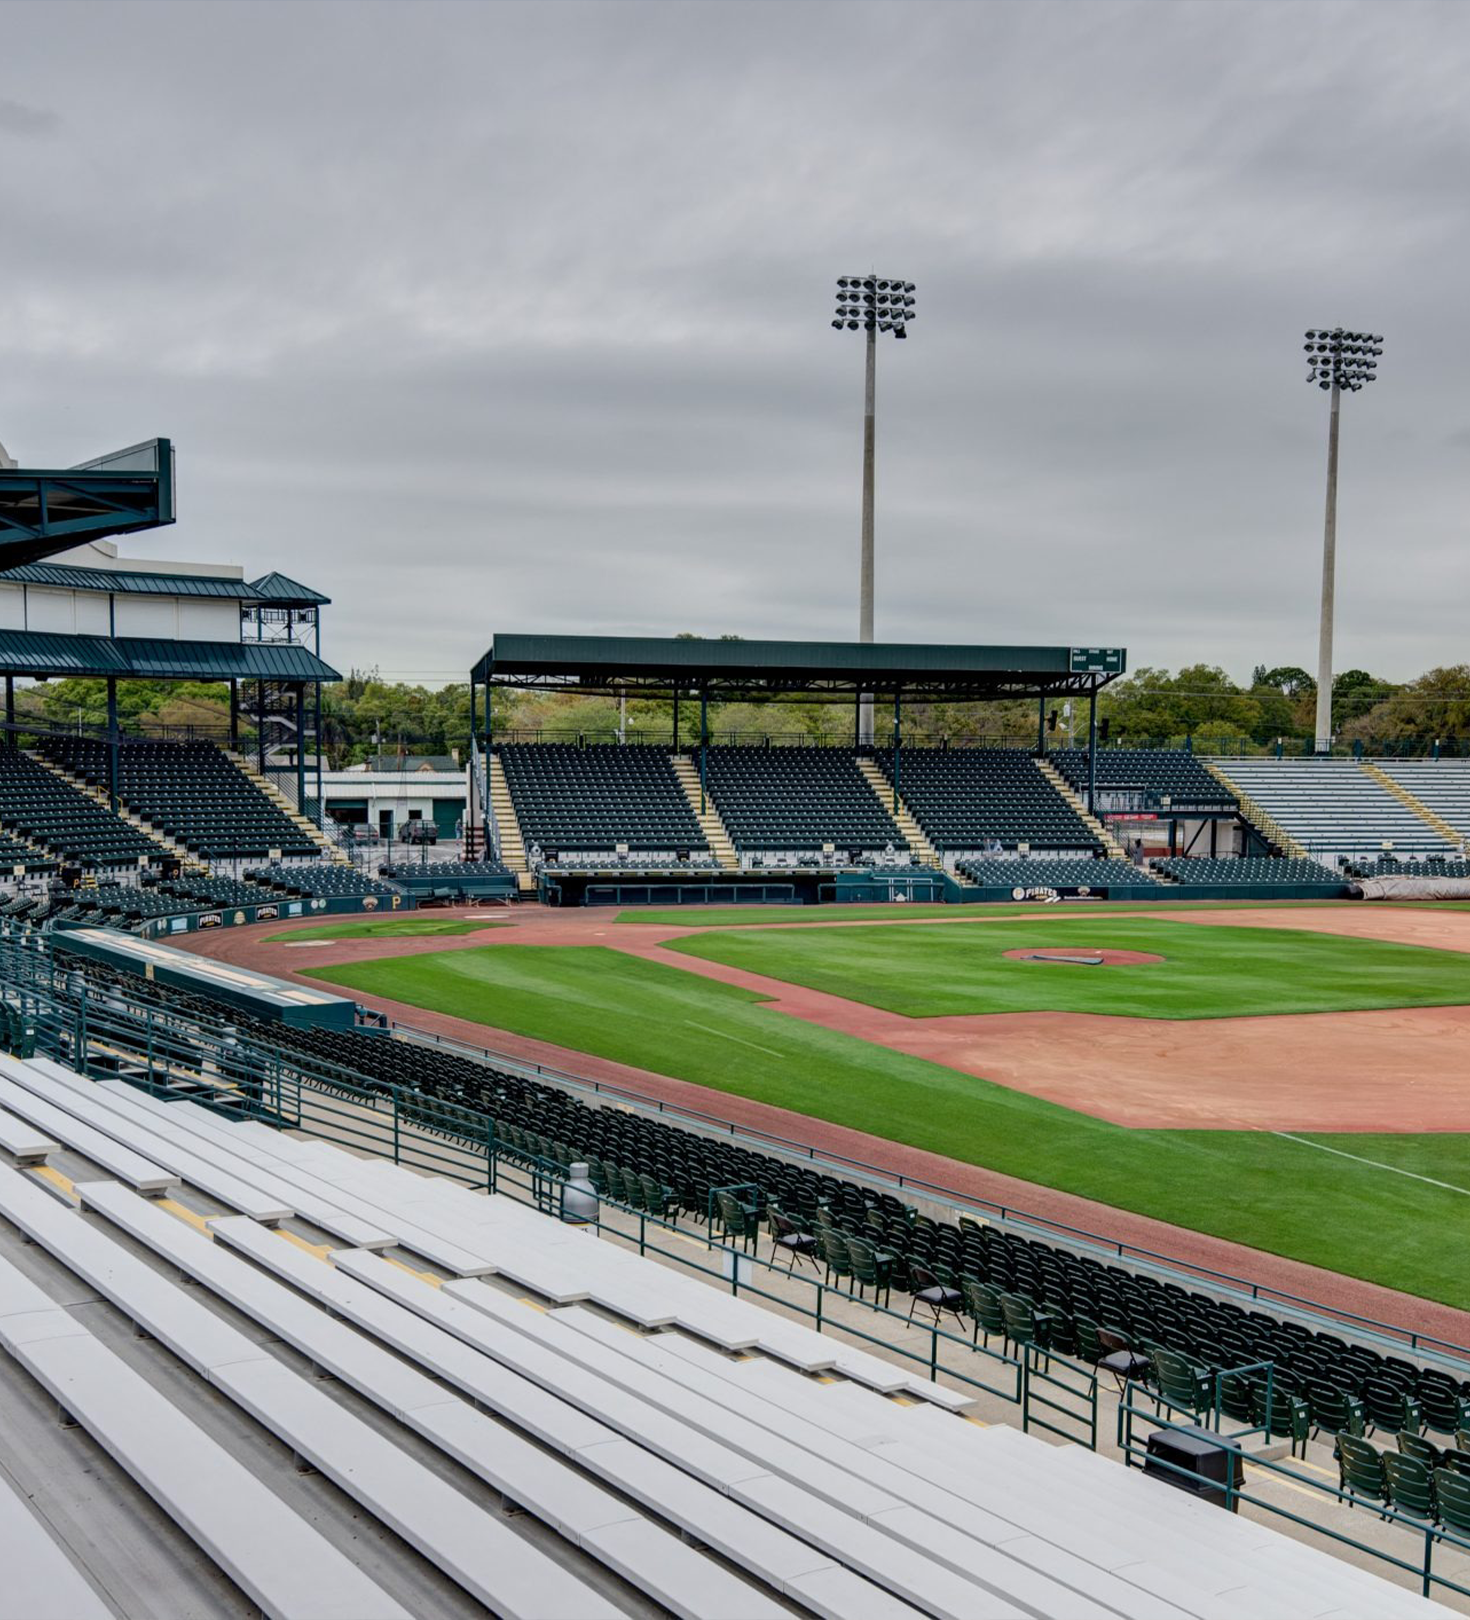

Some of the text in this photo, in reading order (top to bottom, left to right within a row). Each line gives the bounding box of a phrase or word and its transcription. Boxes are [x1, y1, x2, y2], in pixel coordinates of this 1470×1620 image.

[1026, 887, 1058, 898] PIRATES
[392, 896, 401, 909] P
[200, 914, 221, 926] PIRATES
